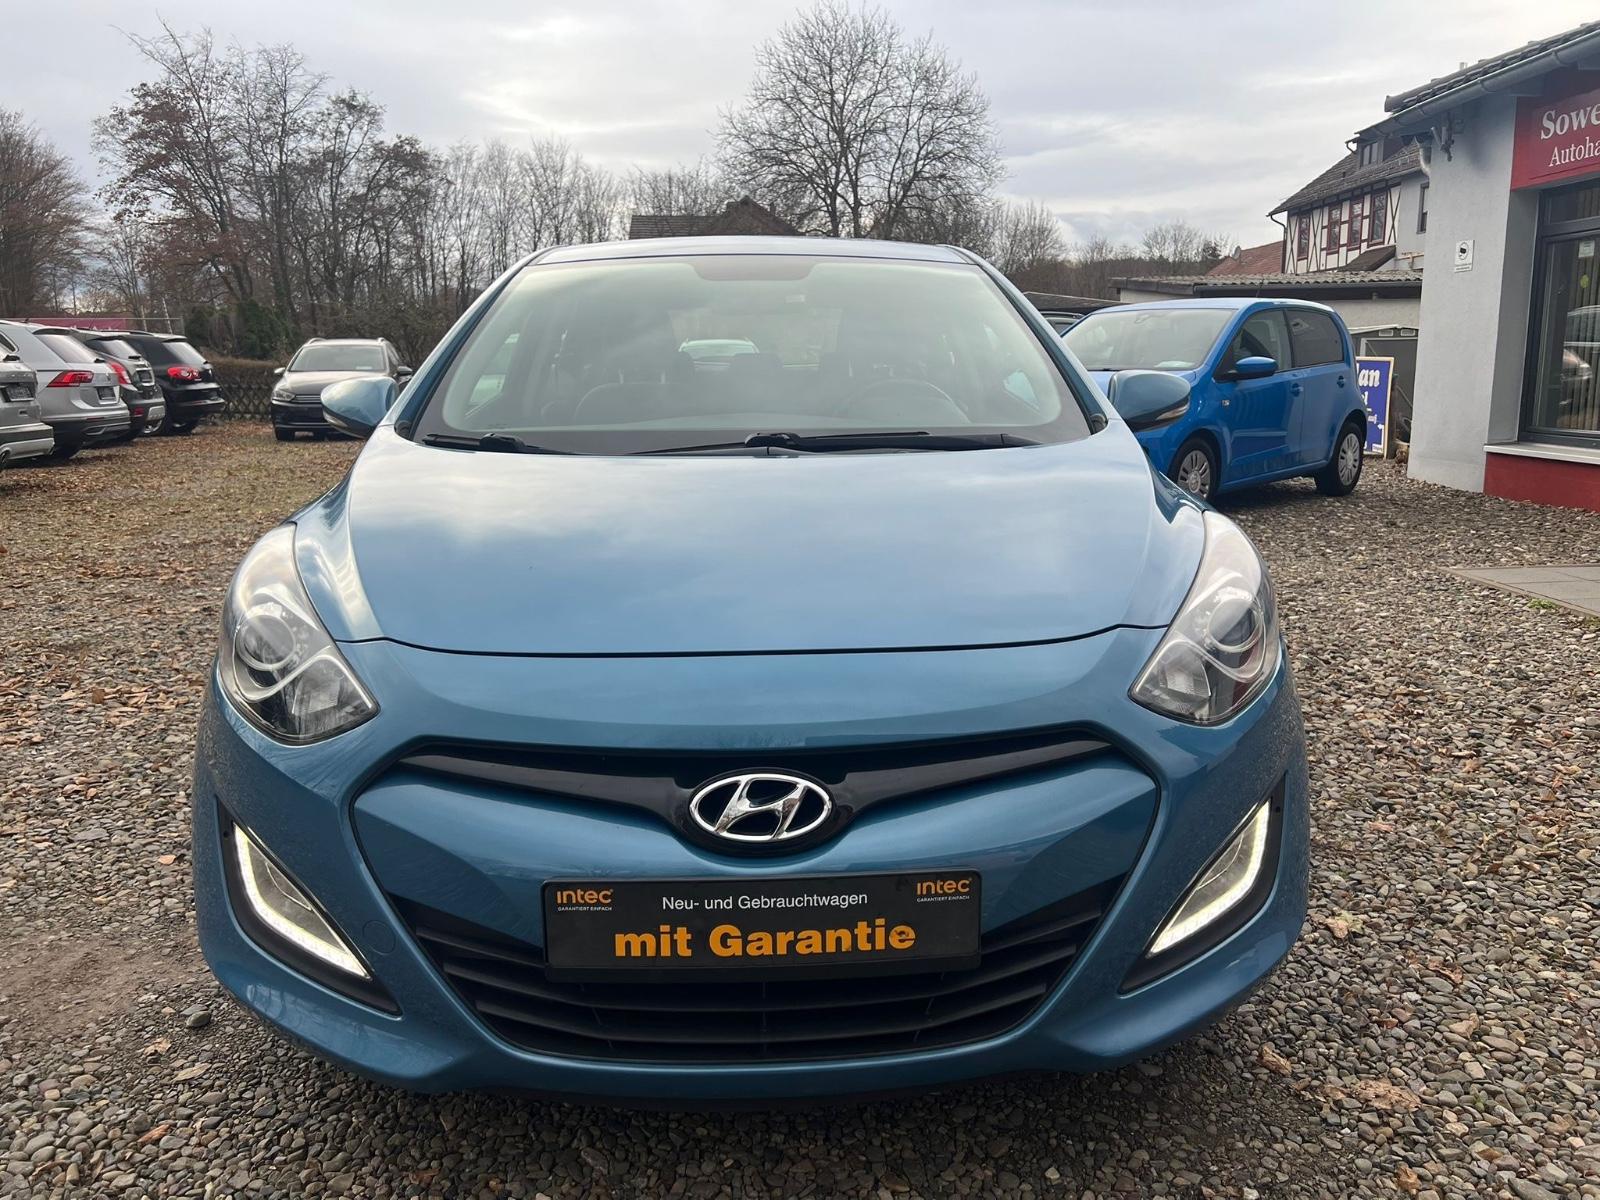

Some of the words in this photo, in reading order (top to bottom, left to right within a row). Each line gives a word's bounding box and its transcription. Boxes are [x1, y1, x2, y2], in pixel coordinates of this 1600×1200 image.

[662, 896, 700, 910] Neu-
[704, 896, 733, 910] und
[737, 893, 868, 909] Gebrauchtwagen
[614, 924, 693, 957] mit
[708, 918, 917, 957] Garantie
